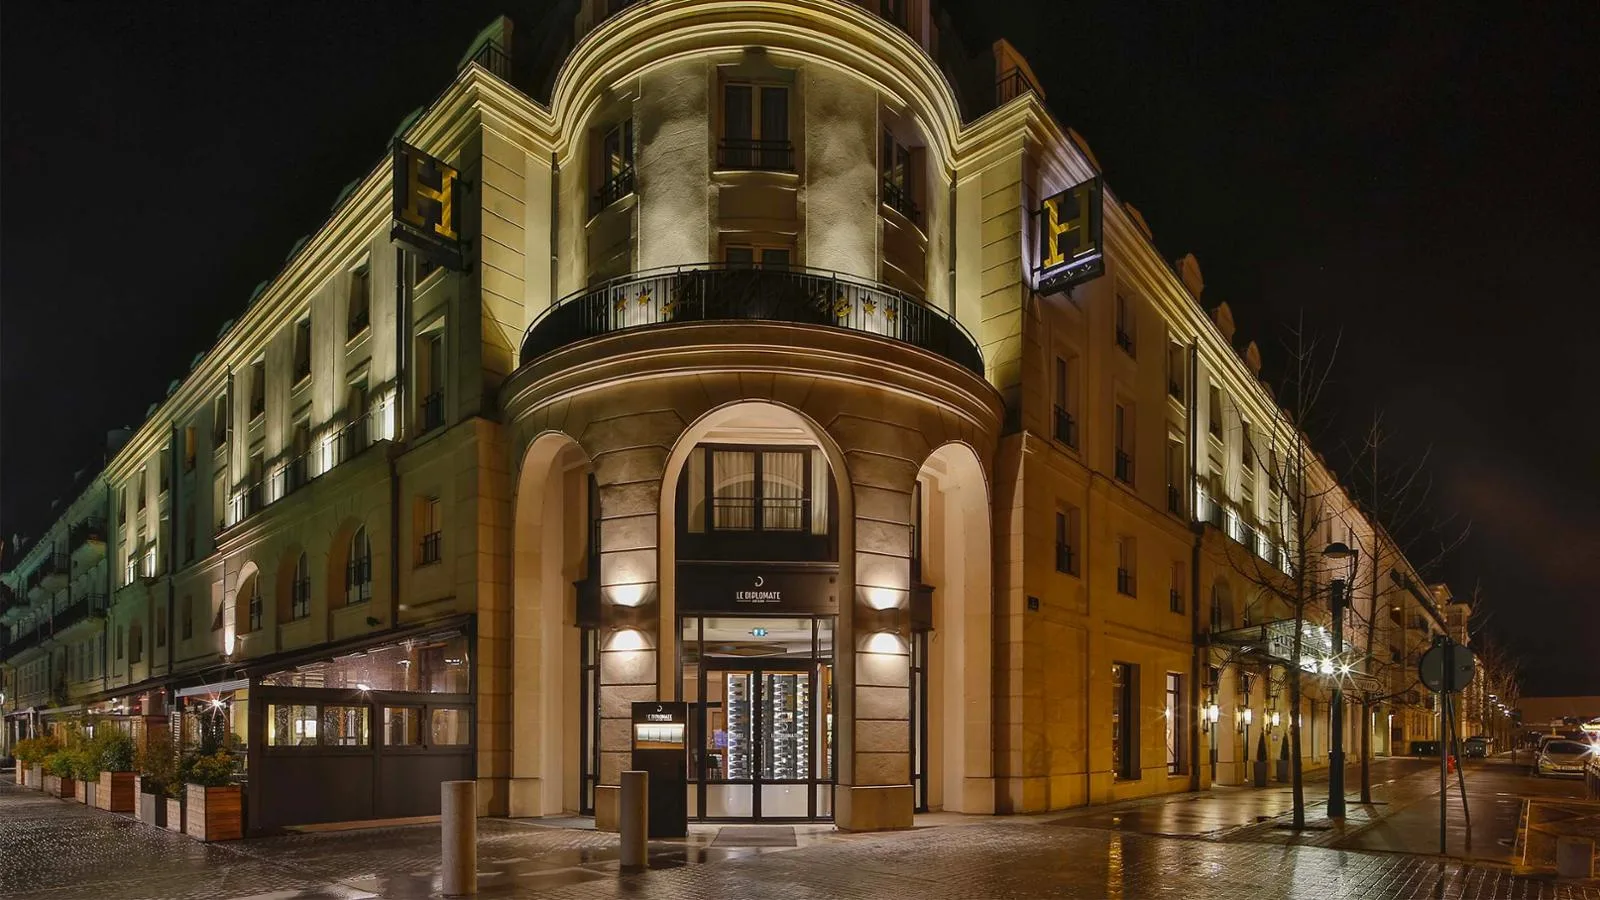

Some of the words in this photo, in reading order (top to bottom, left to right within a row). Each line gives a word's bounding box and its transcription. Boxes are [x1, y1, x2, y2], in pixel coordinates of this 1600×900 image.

[401, 149, 458, 240] H
[1044, 183, 1096, 270] H
[736, 591, 744, 600] LE
[744, 591, 781, 600] DIPLOMATE
